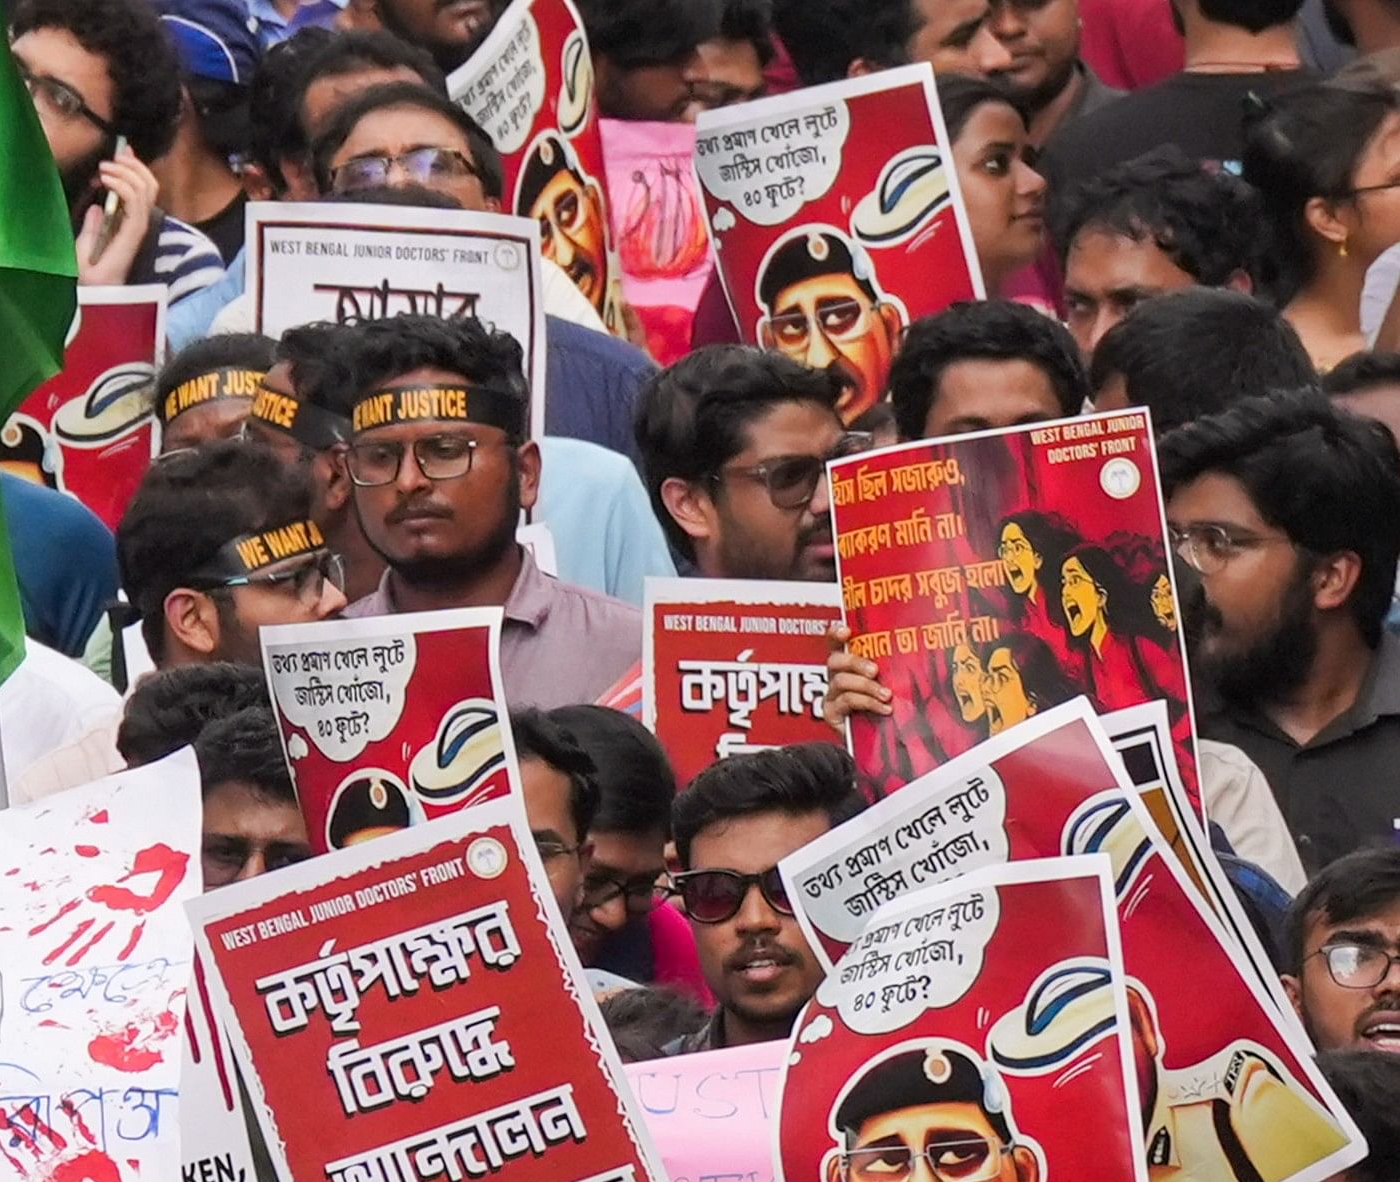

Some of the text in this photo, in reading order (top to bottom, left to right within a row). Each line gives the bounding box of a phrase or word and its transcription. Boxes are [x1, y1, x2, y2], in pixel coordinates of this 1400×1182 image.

[269, 239, 489, 265] WEST BENGAL JUNIOR DOCTORS' FRONT
[396, 389, 468, 420] JUSTICE
[1047, 435, 1137, 465] DOCTORS' FRONT
[236, 522, 310, 570] WE WANT
[803, 777, 991, 902] তথ্য প্রমাণ খেলে লুটে
[220, 857, 465, 950] WEST BENGAL JUNIOR DOCTORS' FRONT
[254, 899, 524, 1037] কর্তৃপক্ষের
[324, 1004, 517, 1117] বিরুদ্ধে
